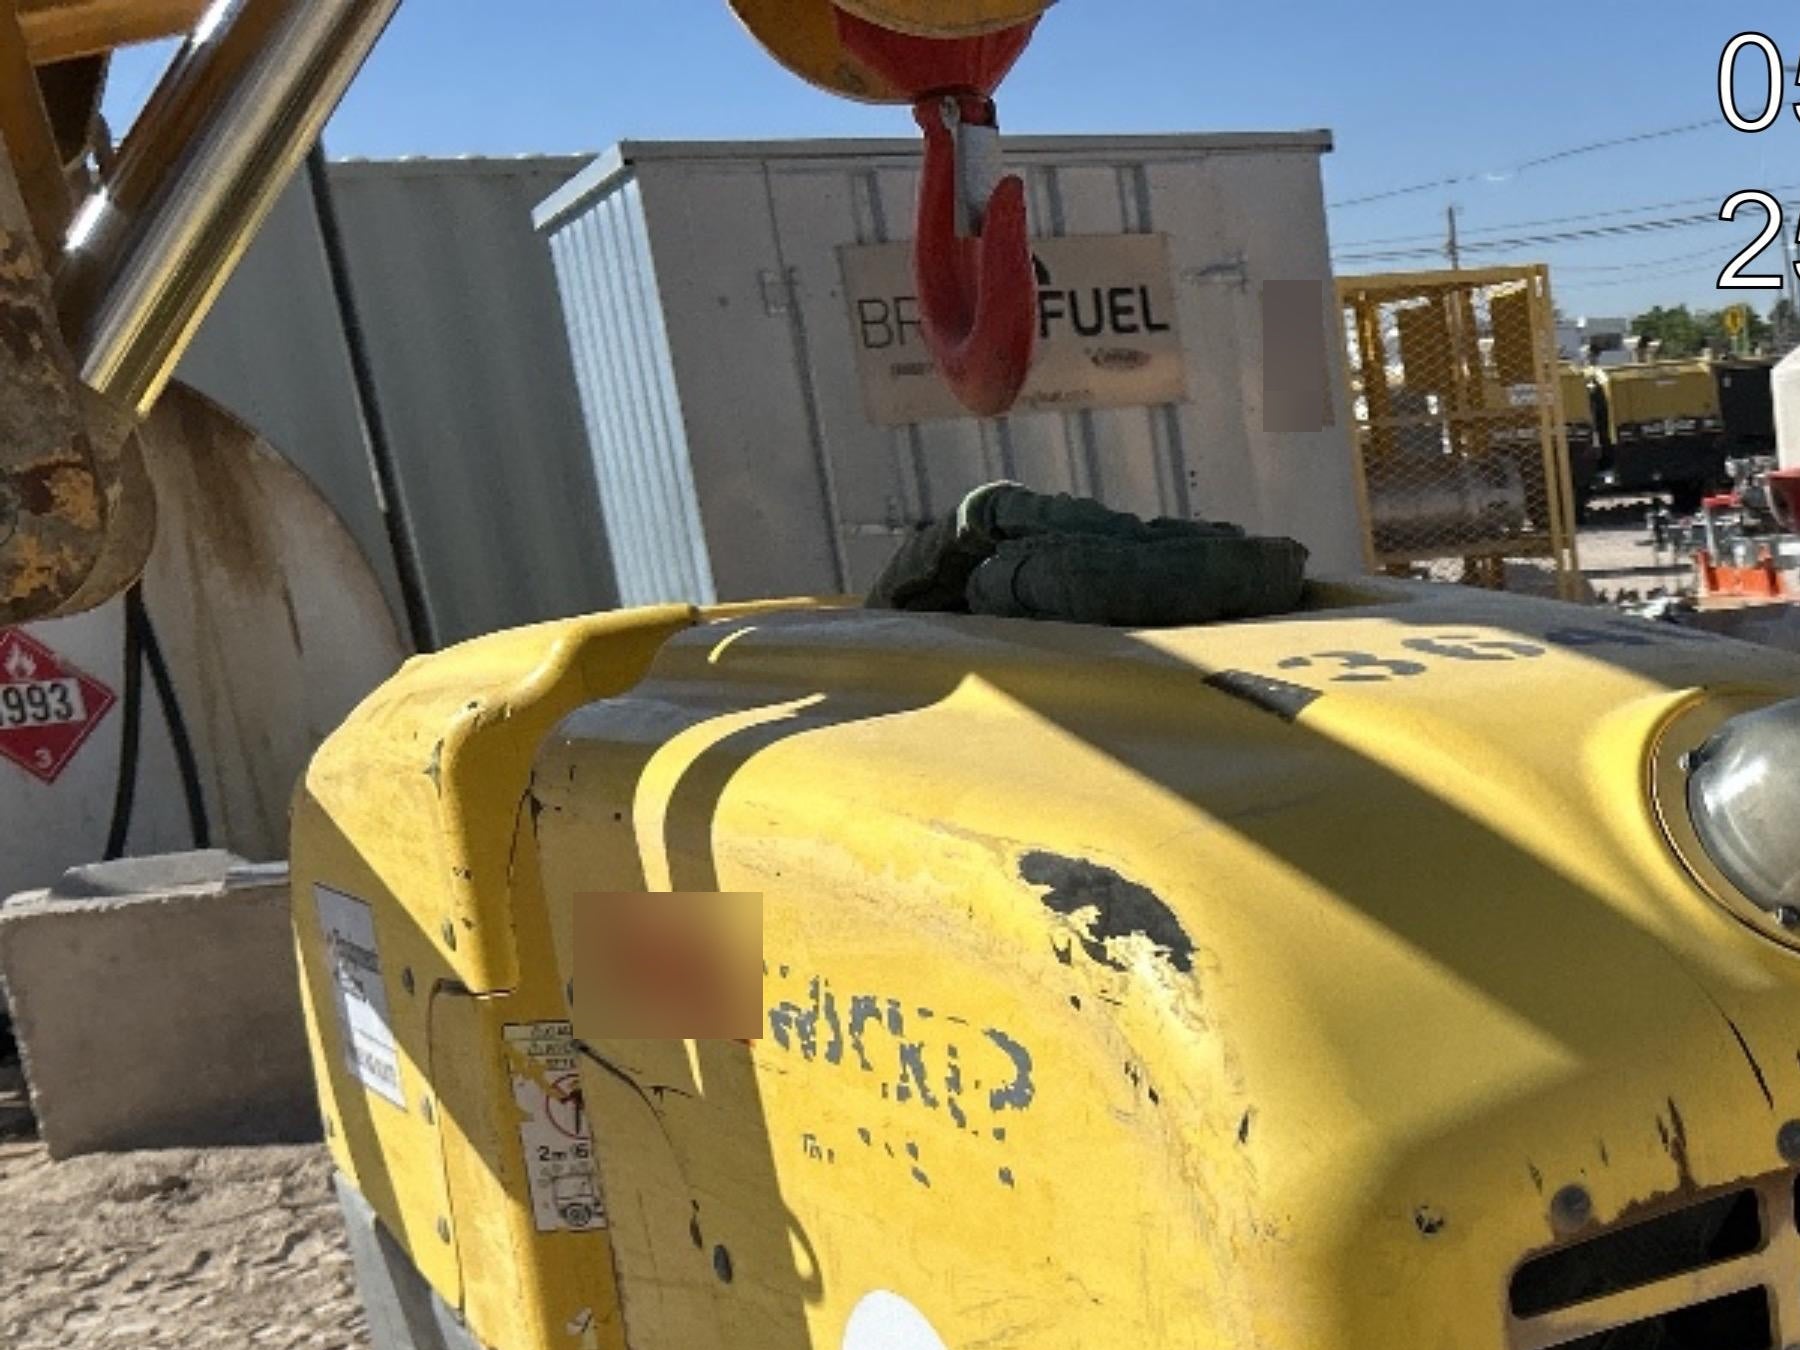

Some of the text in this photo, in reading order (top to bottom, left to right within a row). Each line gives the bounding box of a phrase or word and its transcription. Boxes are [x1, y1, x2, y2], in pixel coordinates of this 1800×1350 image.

[1037, 284, 1172, 339] FUEL
[0, 683, 73, 726] 993
[36, 749, 52, 769] 3
